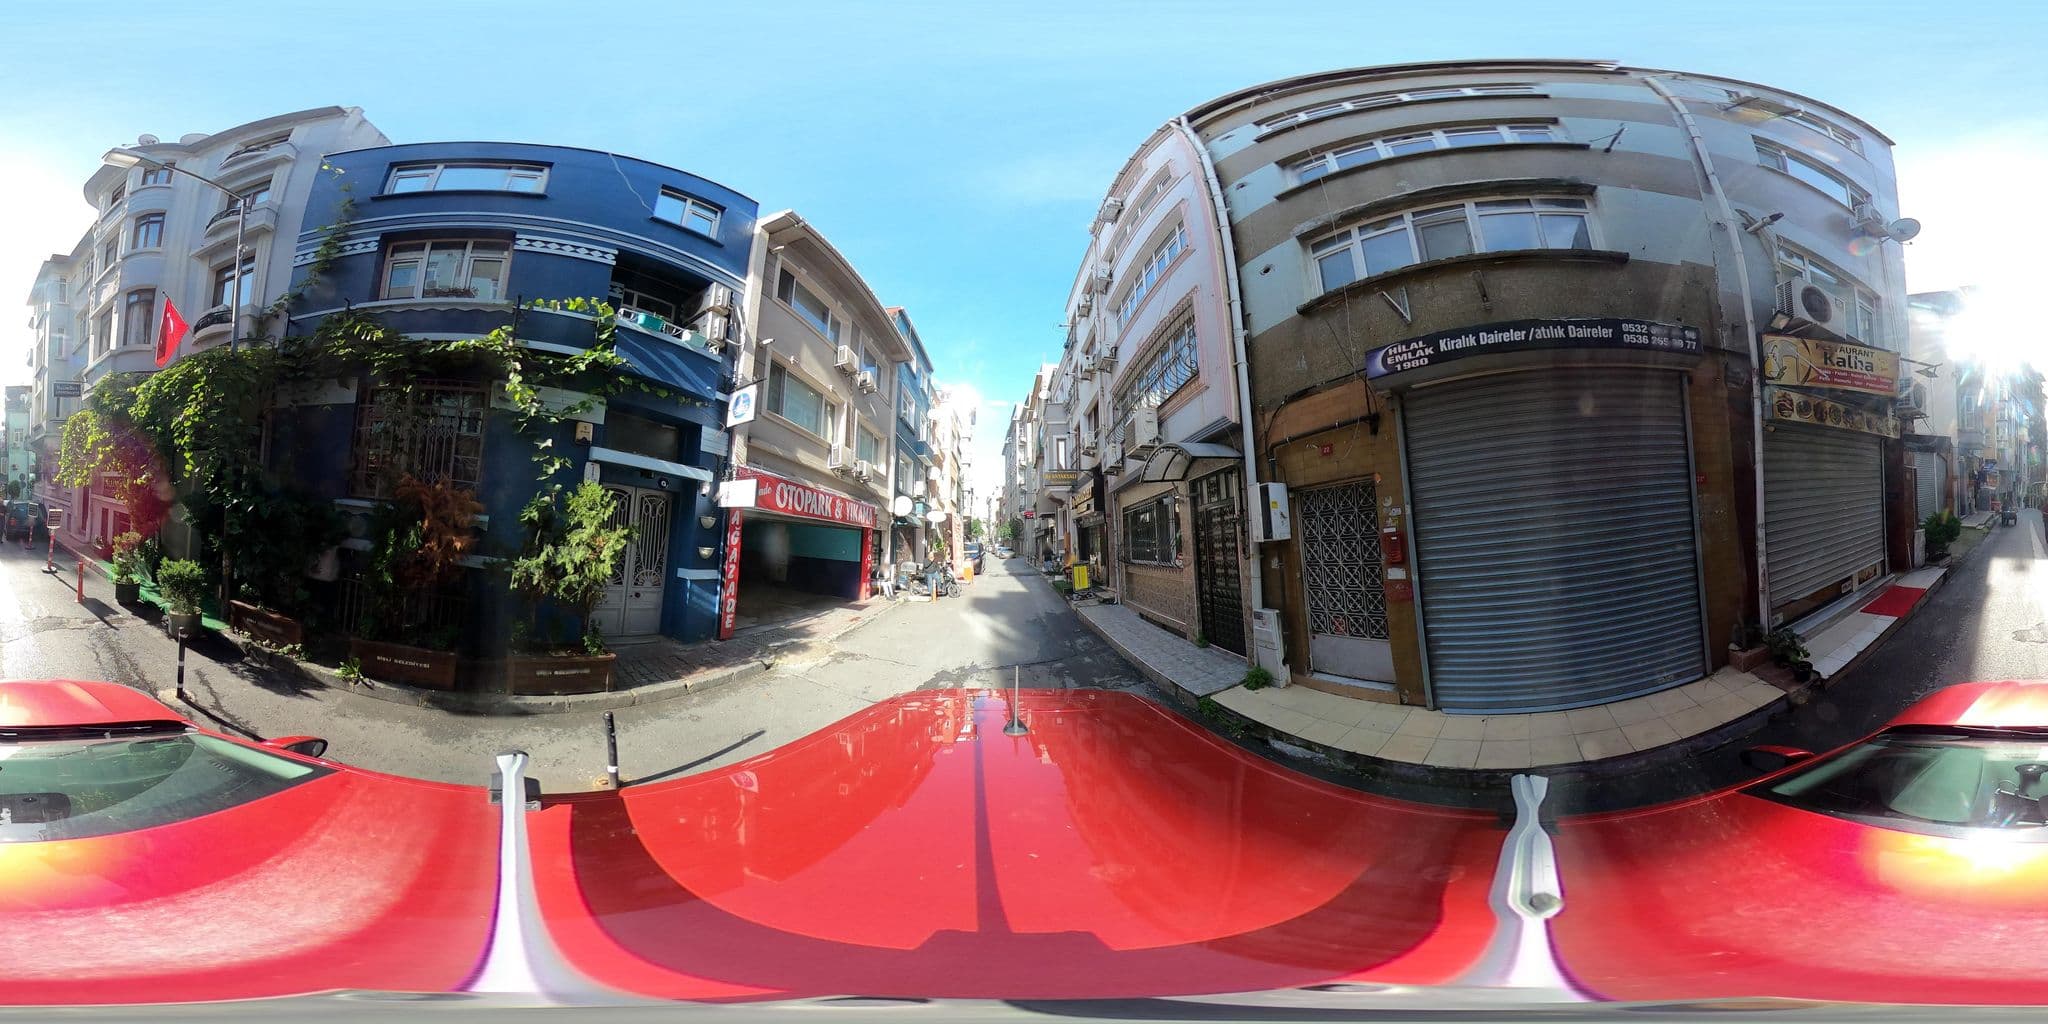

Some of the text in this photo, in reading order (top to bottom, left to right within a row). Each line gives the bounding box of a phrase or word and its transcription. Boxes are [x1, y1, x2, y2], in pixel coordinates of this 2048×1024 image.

[1621, 323, 1648, 334] 0532
[1439, 334, 1477, 352] Kiralık
[1479, 328, 1526, 345] Daireler
[1567, 324, 1613, 339] Daireler
[1623, 333, 1649, 345] 0536
[1387, 346, 1435, 365] EMLAK
[1395, 357, 1429, 371] 1980
[775, 482, 832, 518] OTOPARK
[834, 500, 842, 519] &
[845, 501, 873, 525] YIKAMA
